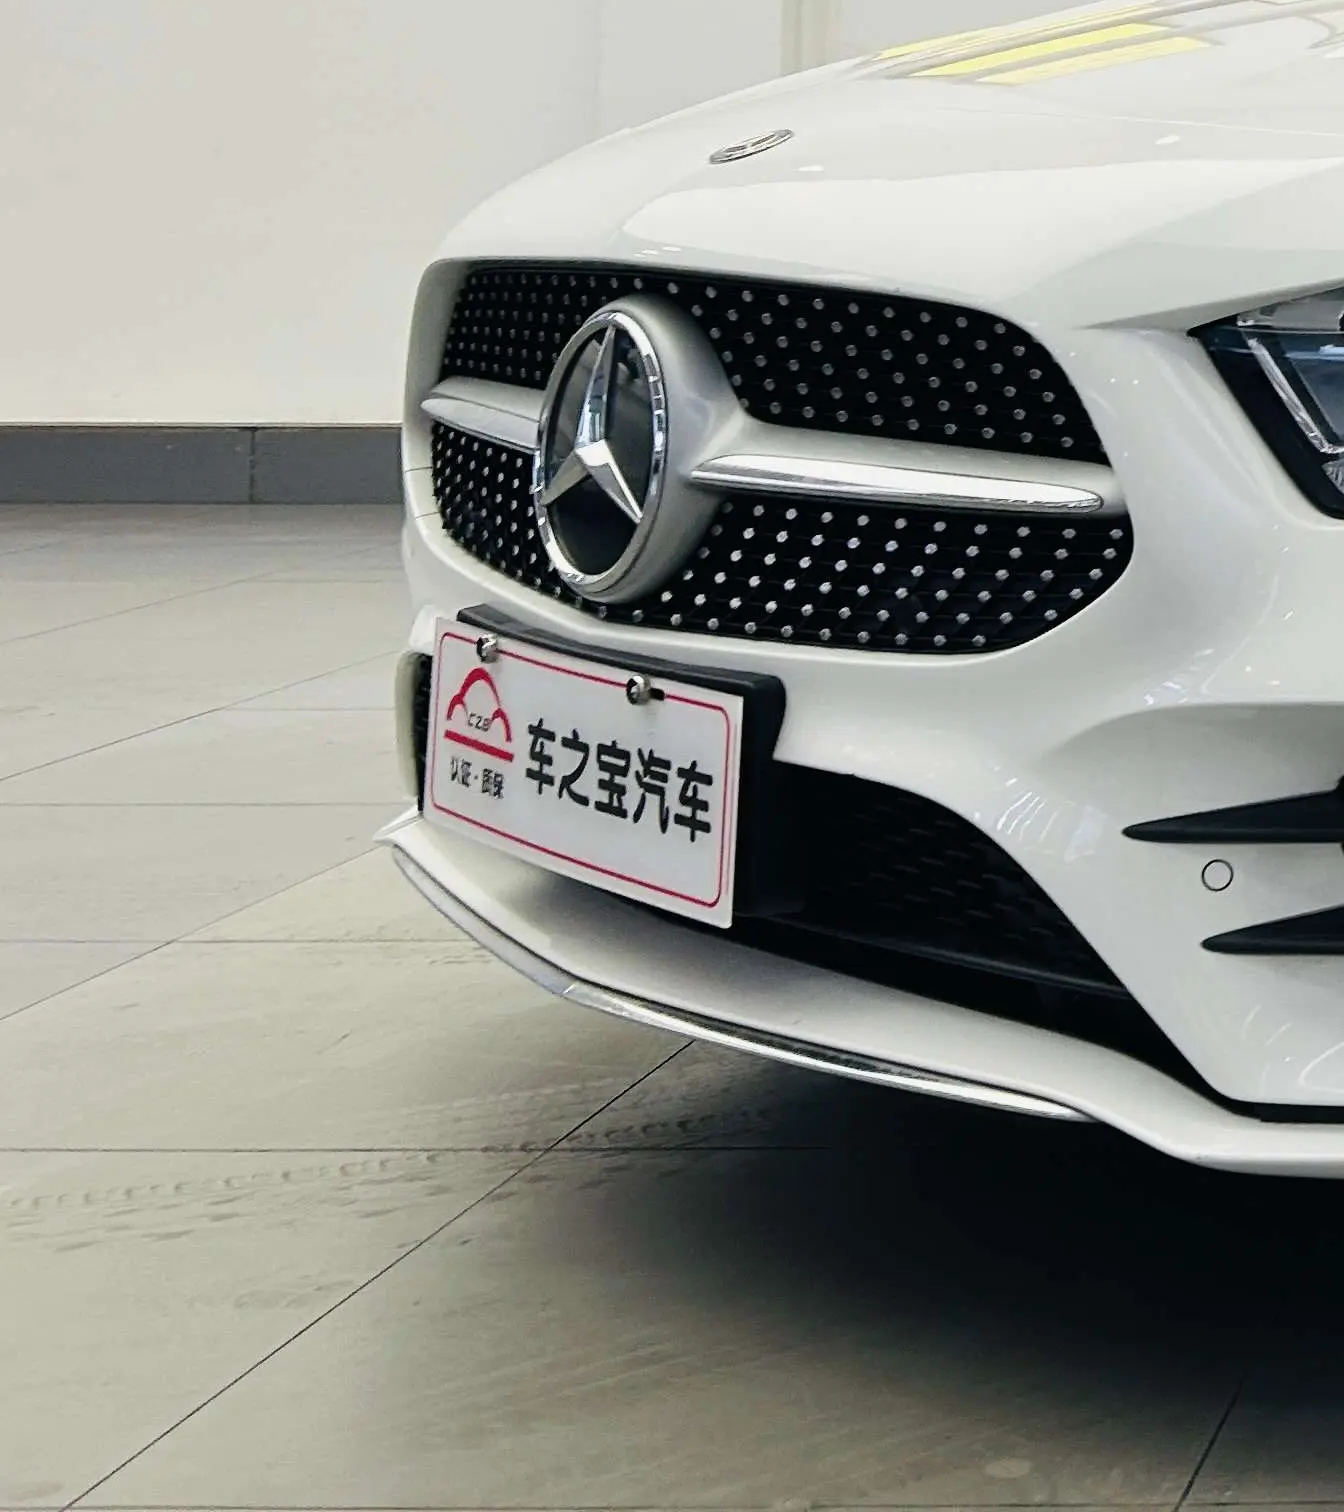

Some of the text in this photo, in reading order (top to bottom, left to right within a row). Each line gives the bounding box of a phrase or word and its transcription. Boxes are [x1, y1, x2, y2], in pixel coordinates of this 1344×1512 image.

[525, 718, 714, 843] 车之宝汽车
